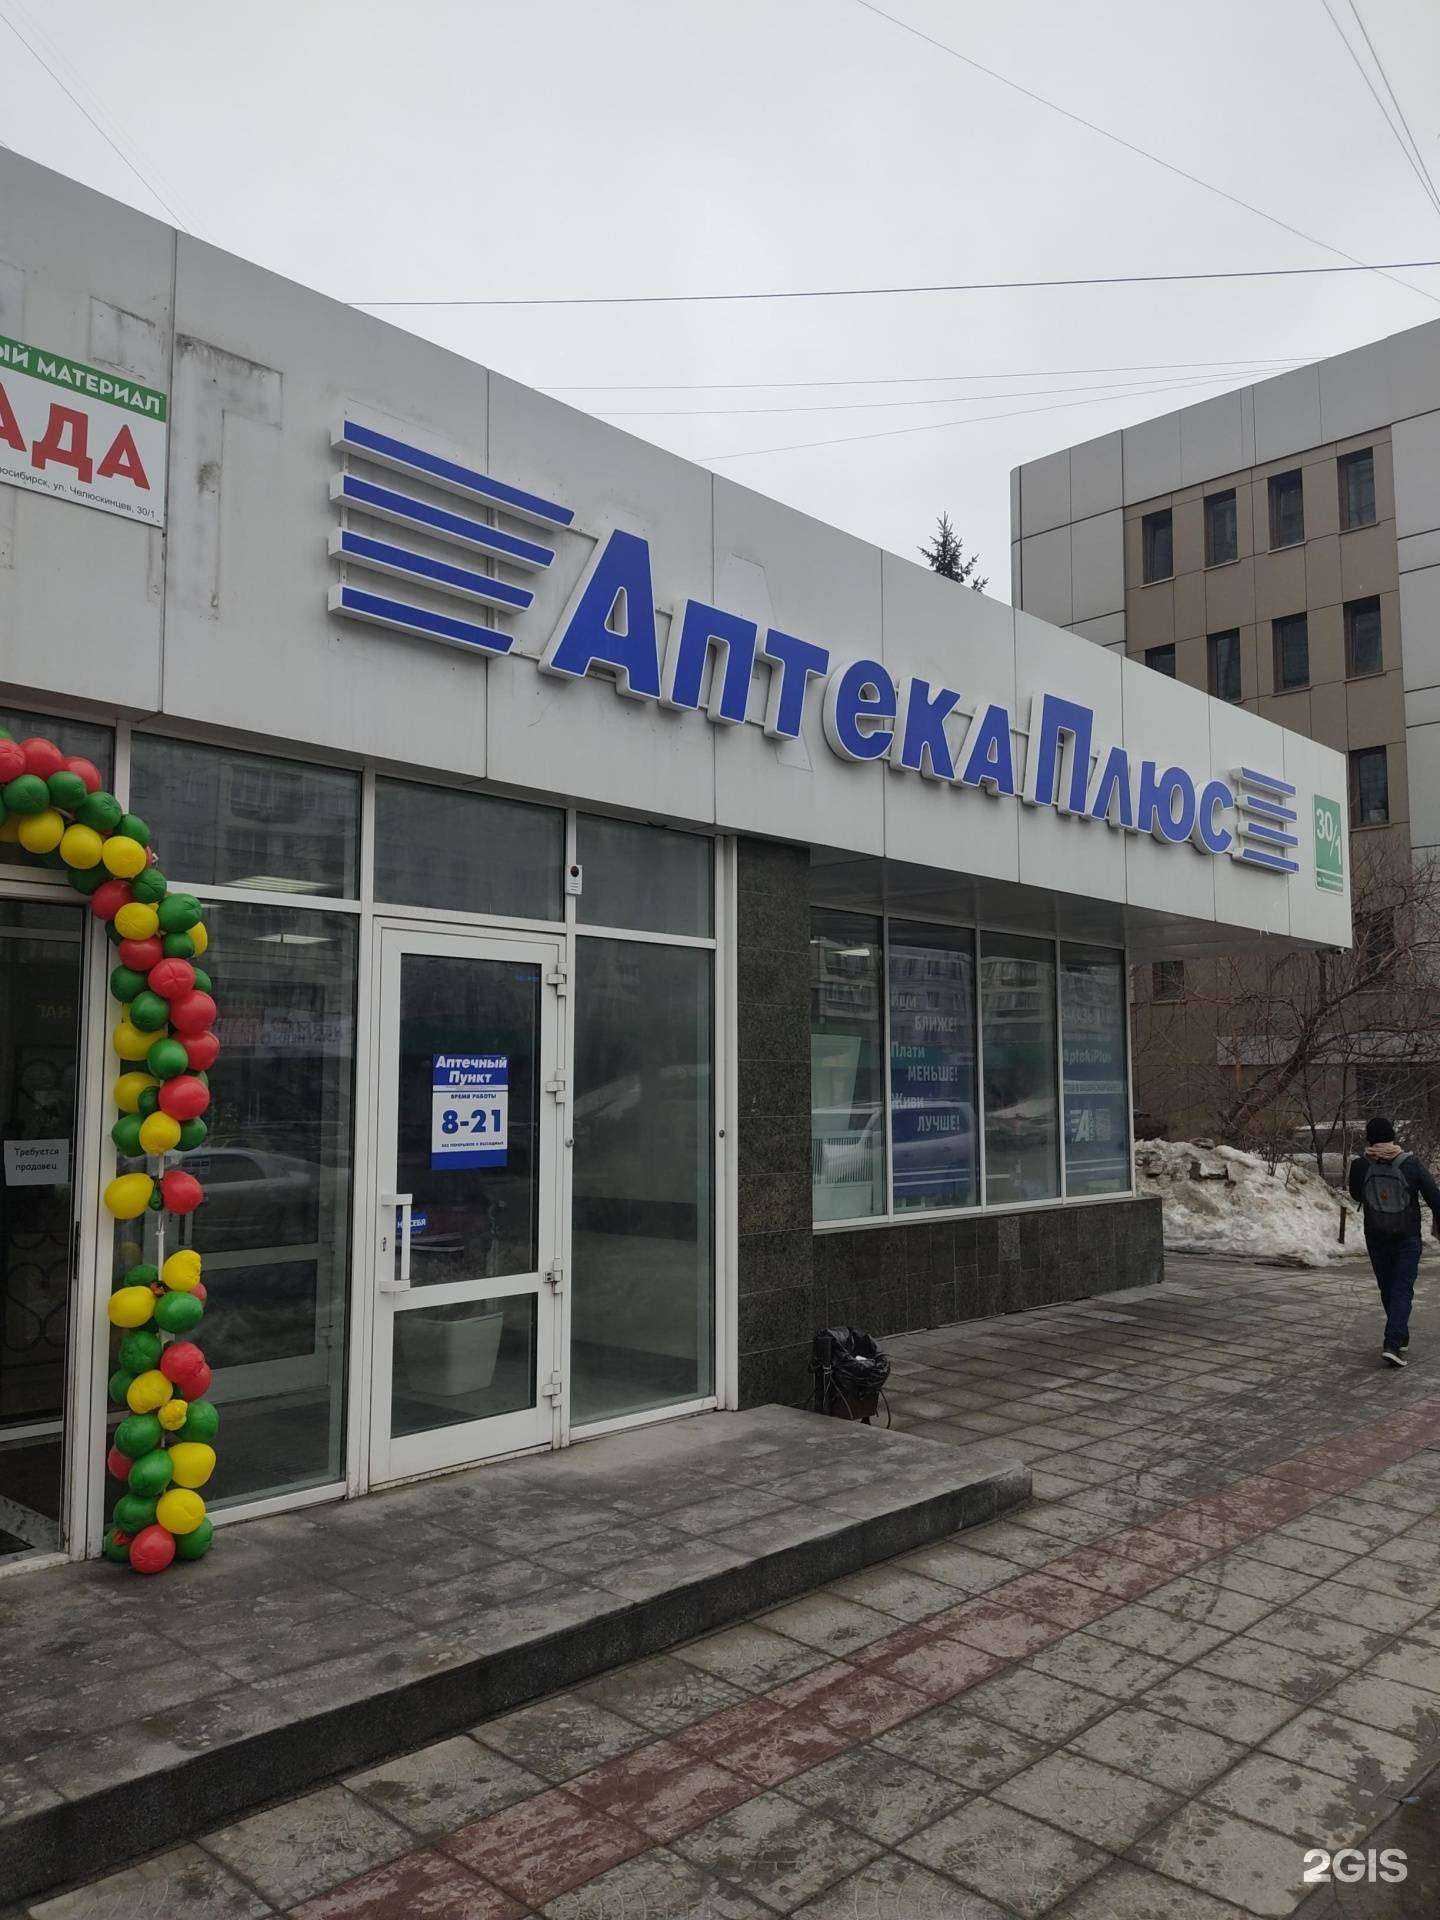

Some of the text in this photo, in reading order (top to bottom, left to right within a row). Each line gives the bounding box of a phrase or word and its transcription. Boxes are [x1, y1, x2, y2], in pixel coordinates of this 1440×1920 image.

[37, 357, 160, 414] МАТЕРИАЛ
[0, 466, 51, 488] осибирск,
[70, 486, 135, 514] Челюскинцев,
[136, 505, 155, 520] 30/1
[1316, 808, 1342, 865] 30/1
[435, 1055, 507, 1069] Аптечный
[448, 1070, 492, 1085] Пункт
[908, 1064, 958, 1082] МЕНЬШЕ!
[441, 1109, 501, 1134] 8-21
[917, 1114, 960, 1132] ЛУЧШЕ!
[14, 1147, 59, 1158] Требуется
